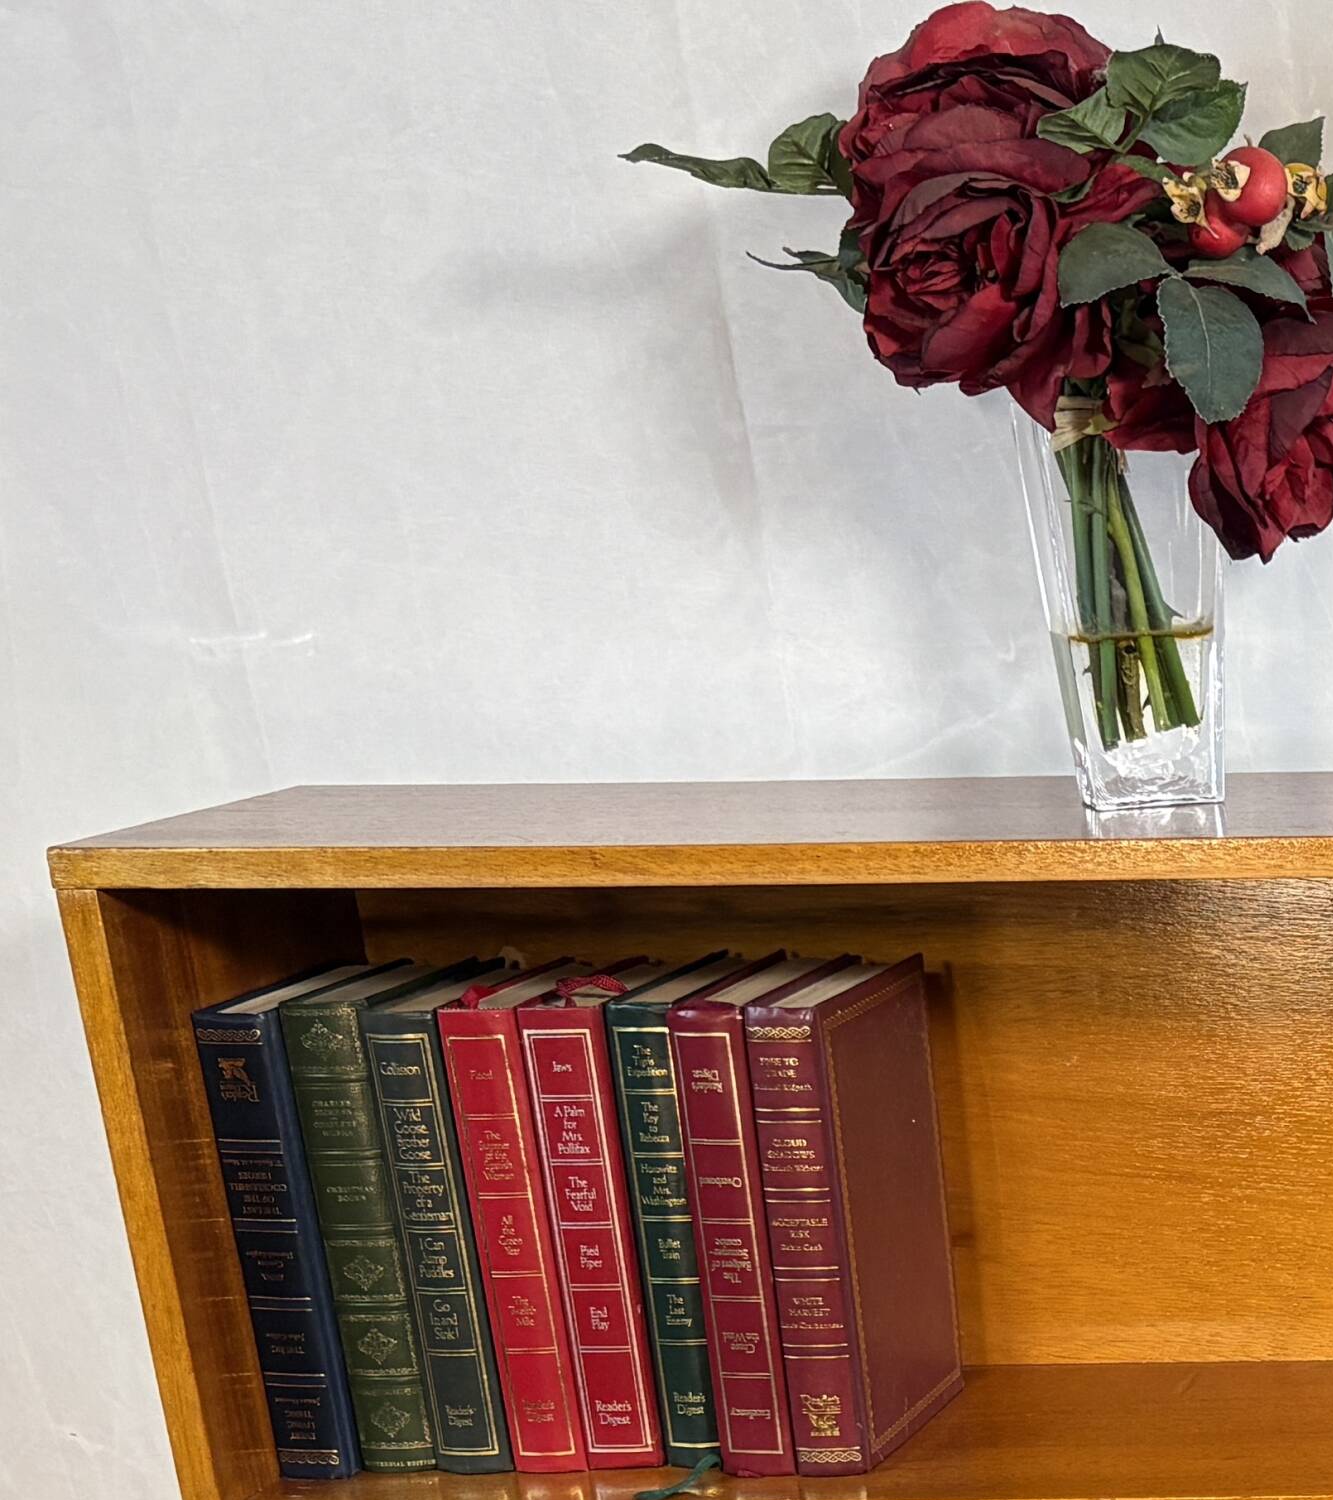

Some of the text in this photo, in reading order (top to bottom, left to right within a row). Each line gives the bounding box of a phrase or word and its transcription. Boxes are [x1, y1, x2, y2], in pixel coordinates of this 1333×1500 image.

[633, 1044, 652, 1057] The
[379, 1061, 420, 1075] Collision
[552, 1059, 572, 1072] Jaws
[553, 1104, 585, 1117] A Palm
[641, 1101, 659, 1113] The
[394, 1108, 422, 1120] Wild
[642, 1113, 660, 1125] Key
[393, 1120, 428, 1133] Goose
[563, 1120, 577, 1129] for
[649, 1125, 659, 1133] to
[397, 1137, 430, 1148] Brother
[399, 1147, 431, 1159] Goose
[409, 1172, 430, 1183] The
[568, 1176, 587, 1187] The
[652, 1174, 668, 1185] and
[403, 1183, 444, 1196] Property
[565, 1188, 596, 1200] Fearful
[570, 1200, 593, 1212] Void
[404, 1211, 452, 1221] Gentleman
[419, 1238, 445, 1248] I Can
[579, 1244, 601, 1256] Pied
[423, 1254, 447, 1264] Jump
[581, 1257, 603, 1270] Piper
[418, 1264, 455, 1277] Puddles
[722, 1272, 742, 1283] The
[666, 1293, 684, 1304] The
[432, 1298, 450, 1312] Go
[668, 1304, 686, 1316] Last
[590, 1305, 608, 1318] End
[591, 1318, 610, 1332] Play
[676, 1404, 705, 1416] Digest
[599, 1413, 630, 1426] Digest
